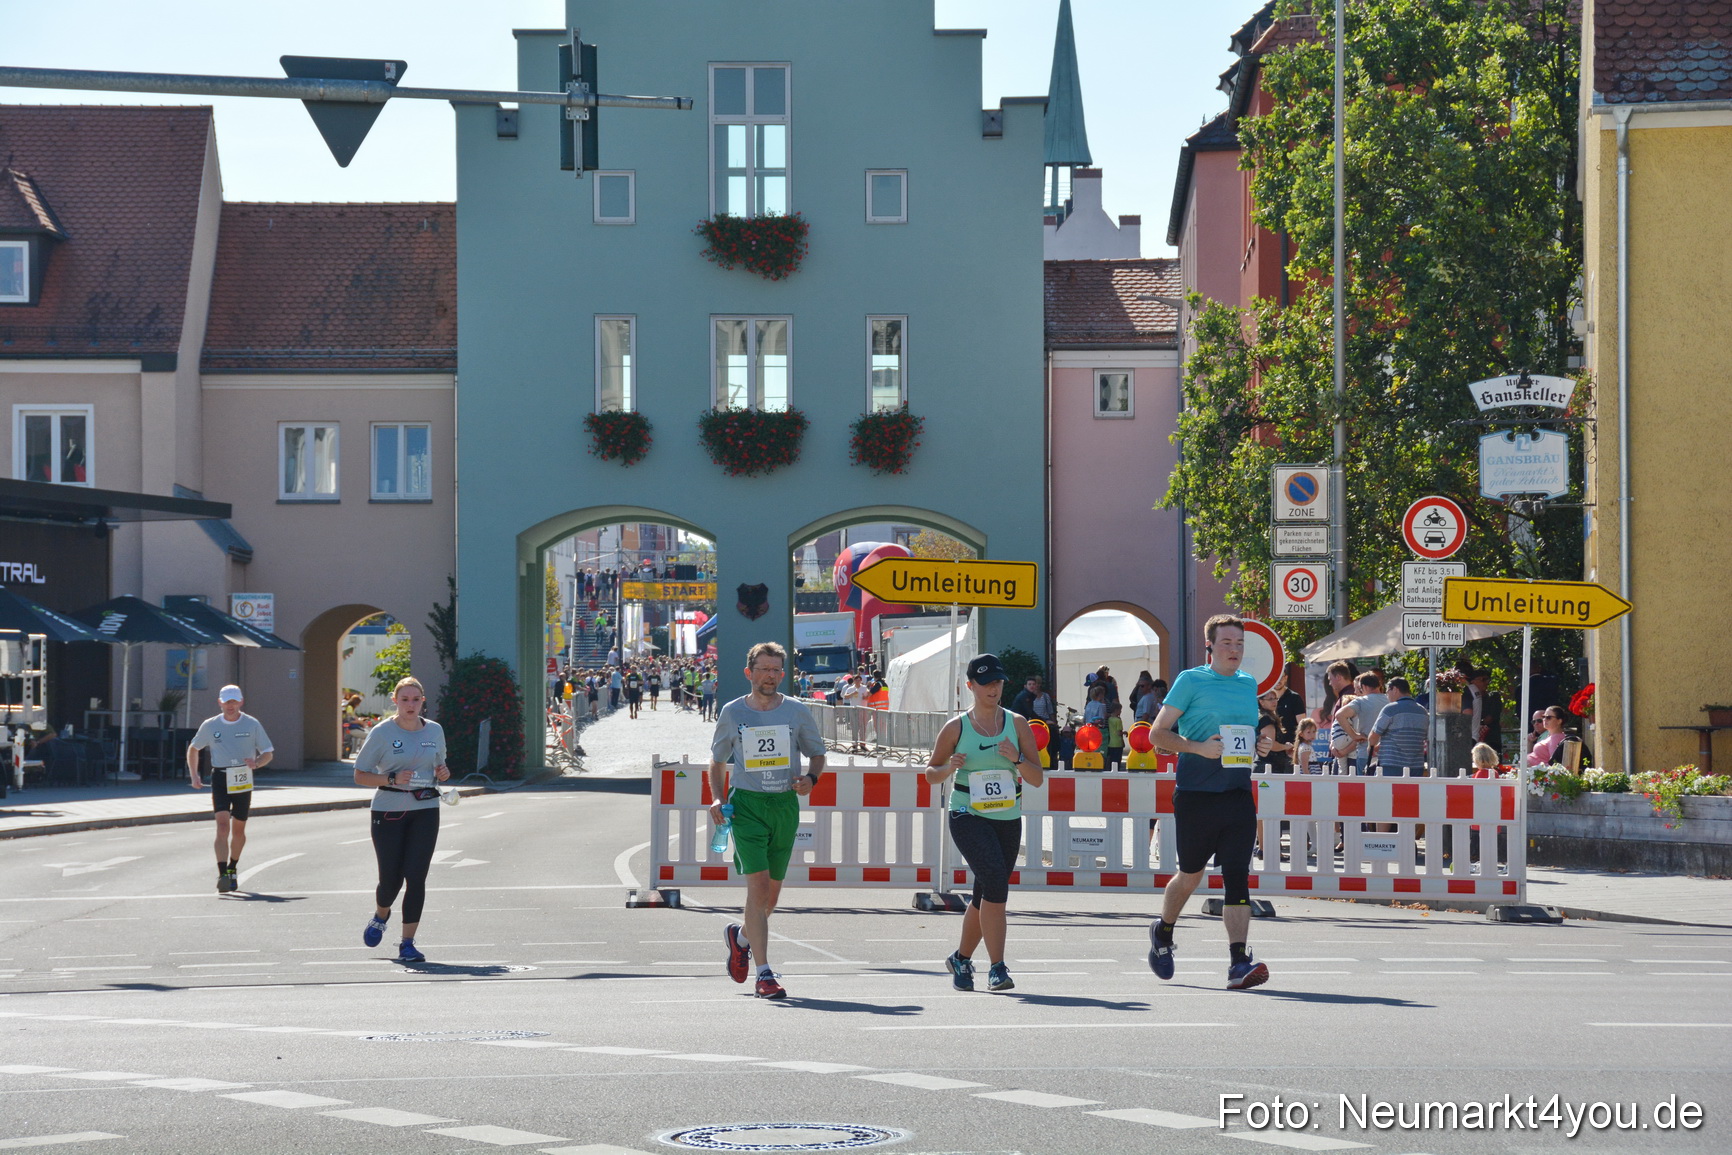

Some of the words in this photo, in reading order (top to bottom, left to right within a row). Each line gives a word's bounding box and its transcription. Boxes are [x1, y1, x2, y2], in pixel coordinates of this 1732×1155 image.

[1480, 387, 1567, 405] Ganskeller
[1486, 452, 1561, 465] GANSBRÄU
[1289, 508, 1315, 517] ZONE
[0, 562, 46, 584] TRAL
[1413, 567, 1426, 575] KFZ
[1428, 567, 1438, 575] bis
[663, 586, 704, 596] START
[892, 570, 1017, 601] Umleitung
[1290, 577, 1310, 593] 30
[1422, 586, 1442, 595] Anlieg
[1407, 596, 1442, 604] Rathauspla
[1464, 590, 1590, 622] Umleitung
[1288, 604, 1314, 613] ZONE
[1448, 632, 1462, 640] frei
[758, 738, 775, 753] 23
[1234, 737, 1246, 750] 21
[762, 771, 775, 779] 19.
[985, 782, 1002, 796] 63
